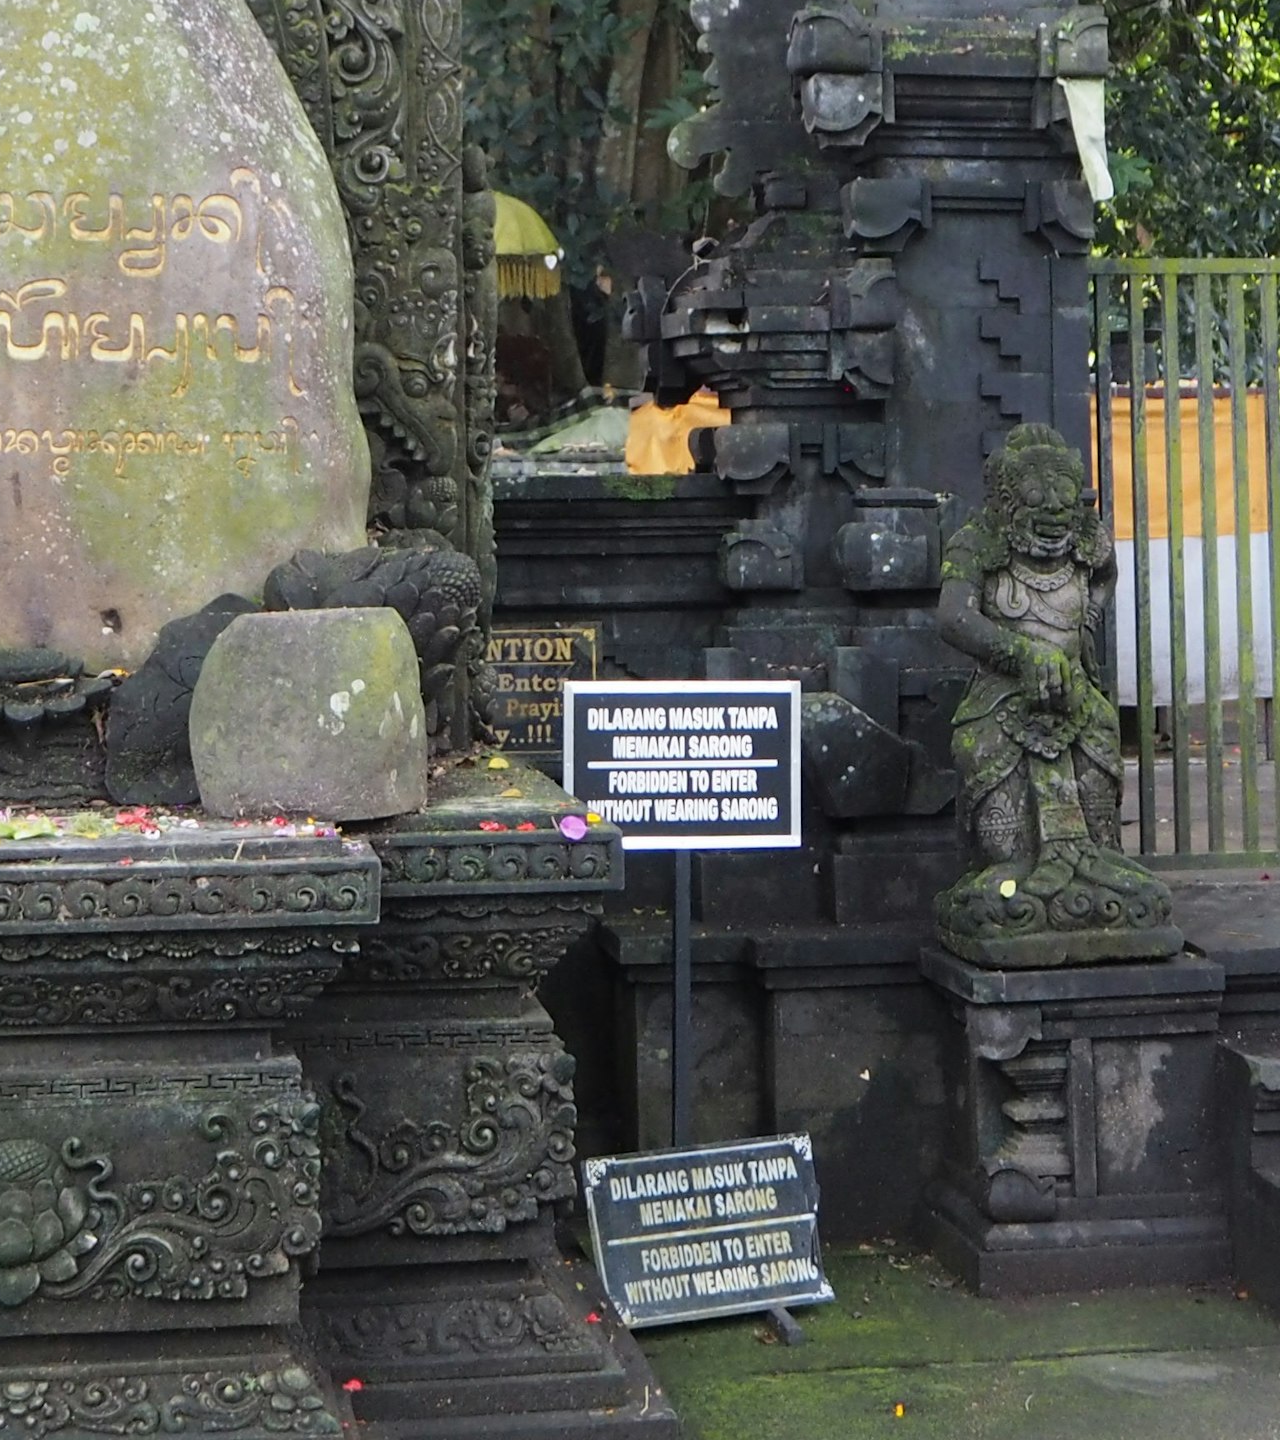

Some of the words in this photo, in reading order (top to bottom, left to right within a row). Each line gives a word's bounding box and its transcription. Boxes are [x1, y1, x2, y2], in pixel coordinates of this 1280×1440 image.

[506, 696, 563, 721] Prayi
[587, 707, 666, 731] DILARANG
[669, 707, 724, 730] MASUK
[728, 706, 779, 730] TANPA
[612, 735, 686, 759] MEMAKAI
[689, 734, 753, 758] SARONG
[608, 770, 687, 794] FORBIDDEN
[690, 770, 708, 792] TO
[712, 769, 758, 792] ENTER
[587, 799, 652, 823] WITHOUT
[654, 798, 719, 822] WEARING
[721, 796, 778, 821] SARONG
[609, 1170, 689, 1203] DILARANG
[690, 1164, 746, 1191] MASUK
[748, 1156, 798, 1182] TANPA
[639, 1197, 712, 1227] MEMAKAI
[715, 1187, 778, 1217] SARONG
[641, 1240, 723, 1273] FORBIDDEN
[724, 1236, 743, 1262] TO
[746, 1229, 793, 1258] ENTER
[624, 1275, 693, 1305] WITHOUT
[694, 1267, 759, 1297] WEARING
[760, 1257, 819, 1288] SARONG
